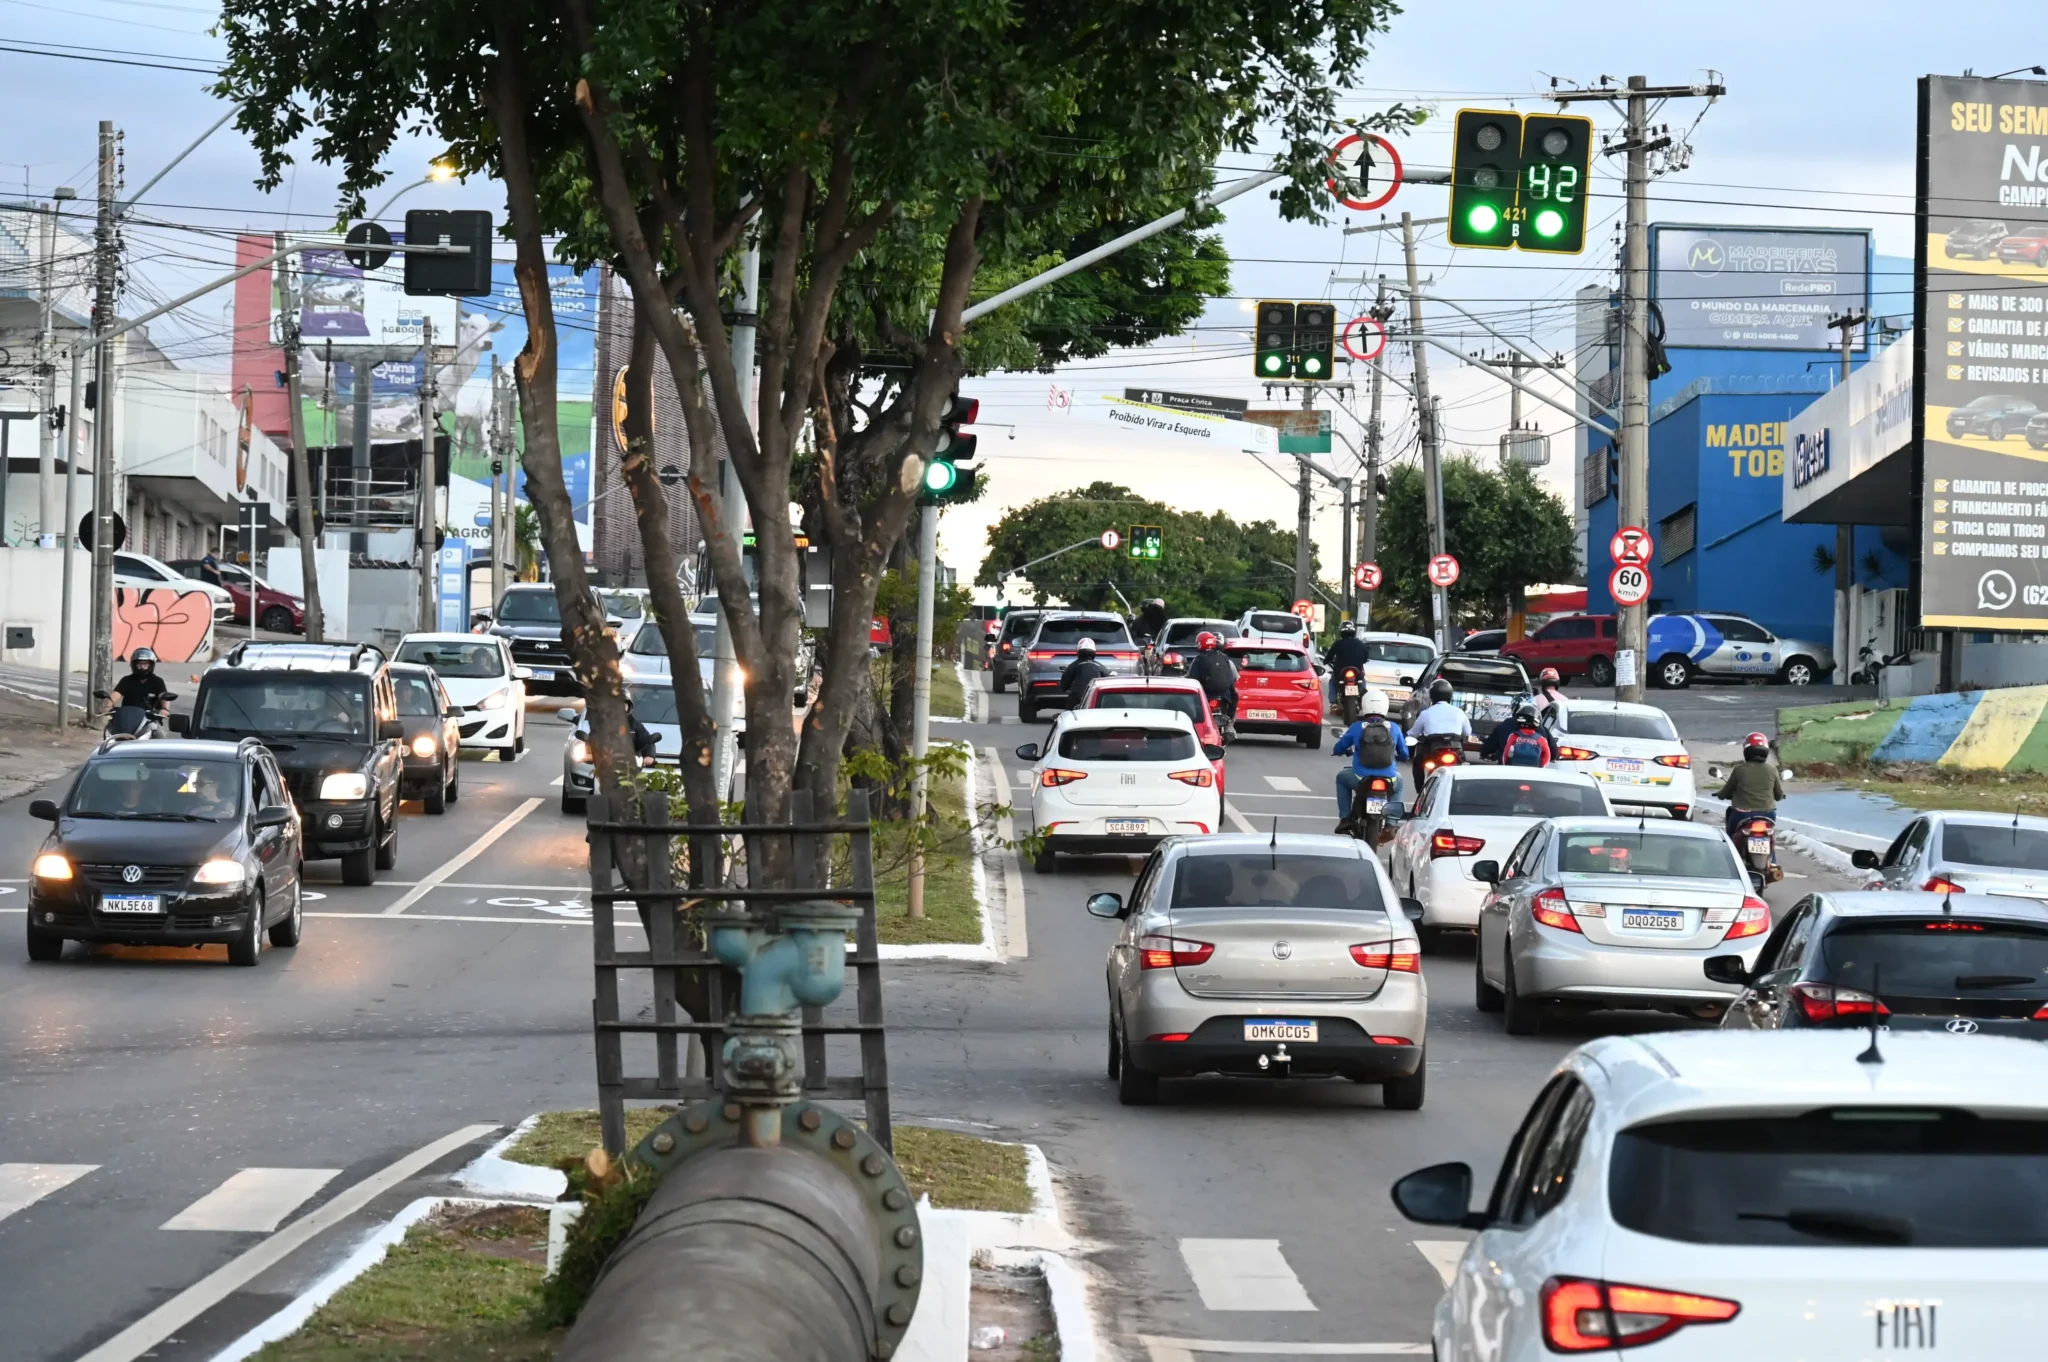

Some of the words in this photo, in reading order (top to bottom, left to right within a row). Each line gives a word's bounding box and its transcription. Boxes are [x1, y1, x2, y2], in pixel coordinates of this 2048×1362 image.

[1951, 101, 1992, 132] SEU
[1529, 164, 1577, 202] 42
[1503, 207, 1526, 221] 421
[1512, 223, 1519, 237] B
[1728, 246, 1837, 258] MADEIREIRA
[1728, 257, 1837, 275] TOBIAS
[1785, 283, 1832, 293] RedePRO
[1691, 301, 1699, 310] O
[1702, 301, 1741, 311] MUNDO
[1743, 302, 1760, 311] DA
[1762, 303, 1831, 313] MARCENARIA
[1968, 294, 1999, 311] MAIS
[2001, 296, 2017, 311] DE
[2019, 297, 2043, 312] 300
[1709, 313, 1770, 328] COMEÇA
[1968, 318, 2023, 336] GARANTIA
[2026, 321, 2041, 336] DE
[1967, 339, 2009, 359] VÁRIAS
[1286, 355, 1300, 363] 311
[388, 374, 416, 385] Total
[1967, 365, 2030, 383] REVISADOS
[2032, 368, 2040, 383] E
[1169, 396, 1190, 404] Praça
[1109, 409, 1145, 425] Proibido
[1146, 418, 1166, 430] Virar
[1174, 422, 1212, 438] Esquerda
[1952, 479, 2001, 494] GARANTIA
[2004, 482, 2017, 495] DE
[1952, 500, 2032, 517] FINANCIAMENTO
[1952, 521, 1984, 536] TROCA
[1987, 522, 2010, 537] COM
[2013, 523, 2045, 538] TROCO
[1146, 537, 1160, 548] 64
[1952, 542, 2018, 558] COMPRAMOS
[2020, 545, 2040, 559] SEU
[1619, 570, 1642, 588] 60
[1617, 588, 1639, 598] km/h
[1110, 823, 1145, 831] SCA3B92
[107, 901, 153, 911] NKL5E68
[1874, 1299, 1944, 1349] FIAT
